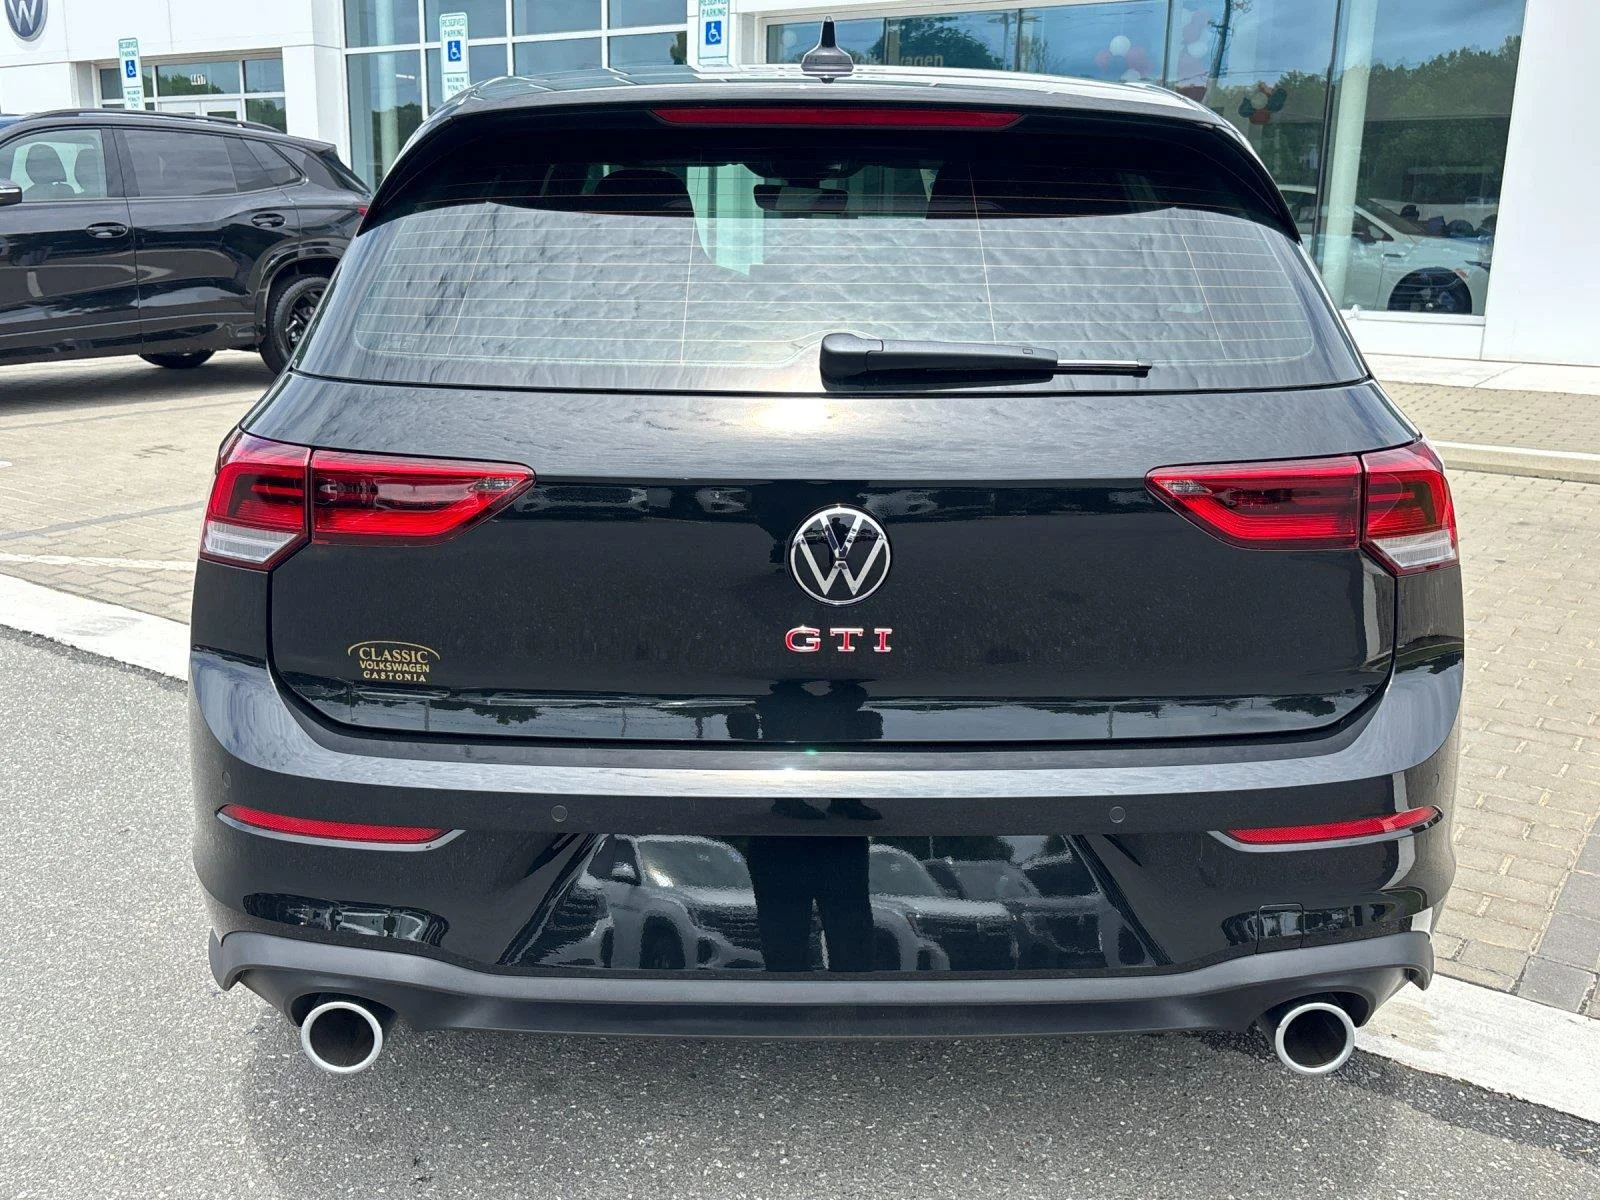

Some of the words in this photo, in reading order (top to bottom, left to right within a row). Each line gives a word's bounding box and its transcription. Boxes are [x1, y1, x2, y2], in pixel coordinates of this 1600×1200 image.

[702, 8, 727, 17] PARKING
[441, 18, 465, 26] RESERVED
[443, 29, 464, 38] PARKING
[785, 626, 893, 654] GTI
[359, 647, 428, 663] CLASSIC
[359, 661, 429, 672] VOLKSWAGEN
[363, 671, 426, 682] GASTONIA
